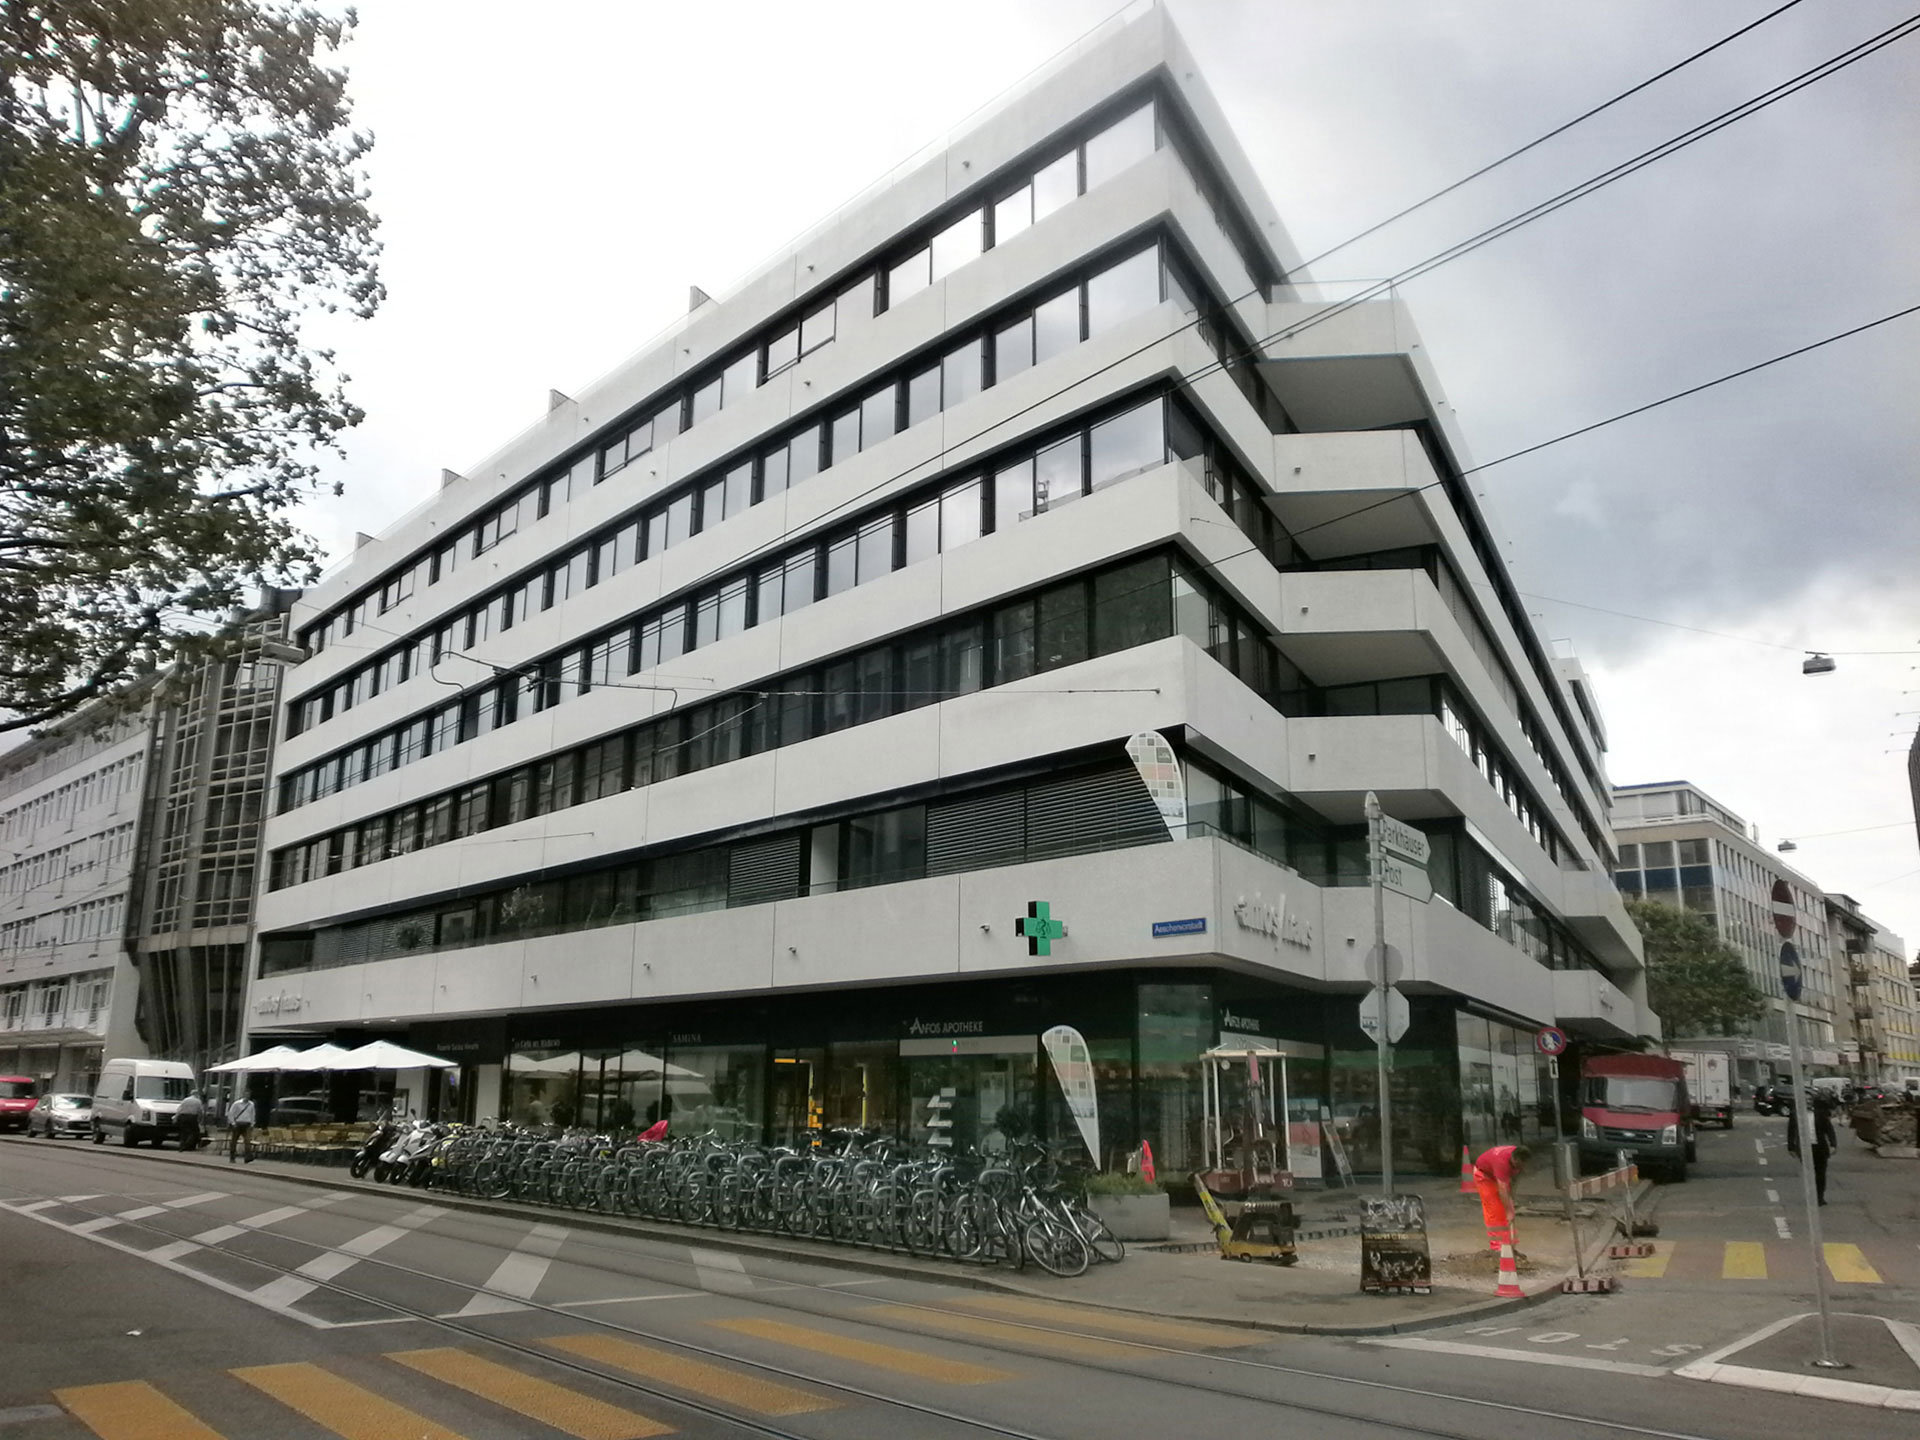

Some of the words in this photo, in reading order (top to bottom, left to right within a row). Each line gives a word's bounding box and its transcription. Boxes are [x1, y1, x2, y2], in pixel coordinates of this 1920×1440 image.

[1383, 819, 1425, 857] Parkhäuser
[1383, 859, 1402, 887] Post
[942, 1021, 983, 1033] APOTHEKE
